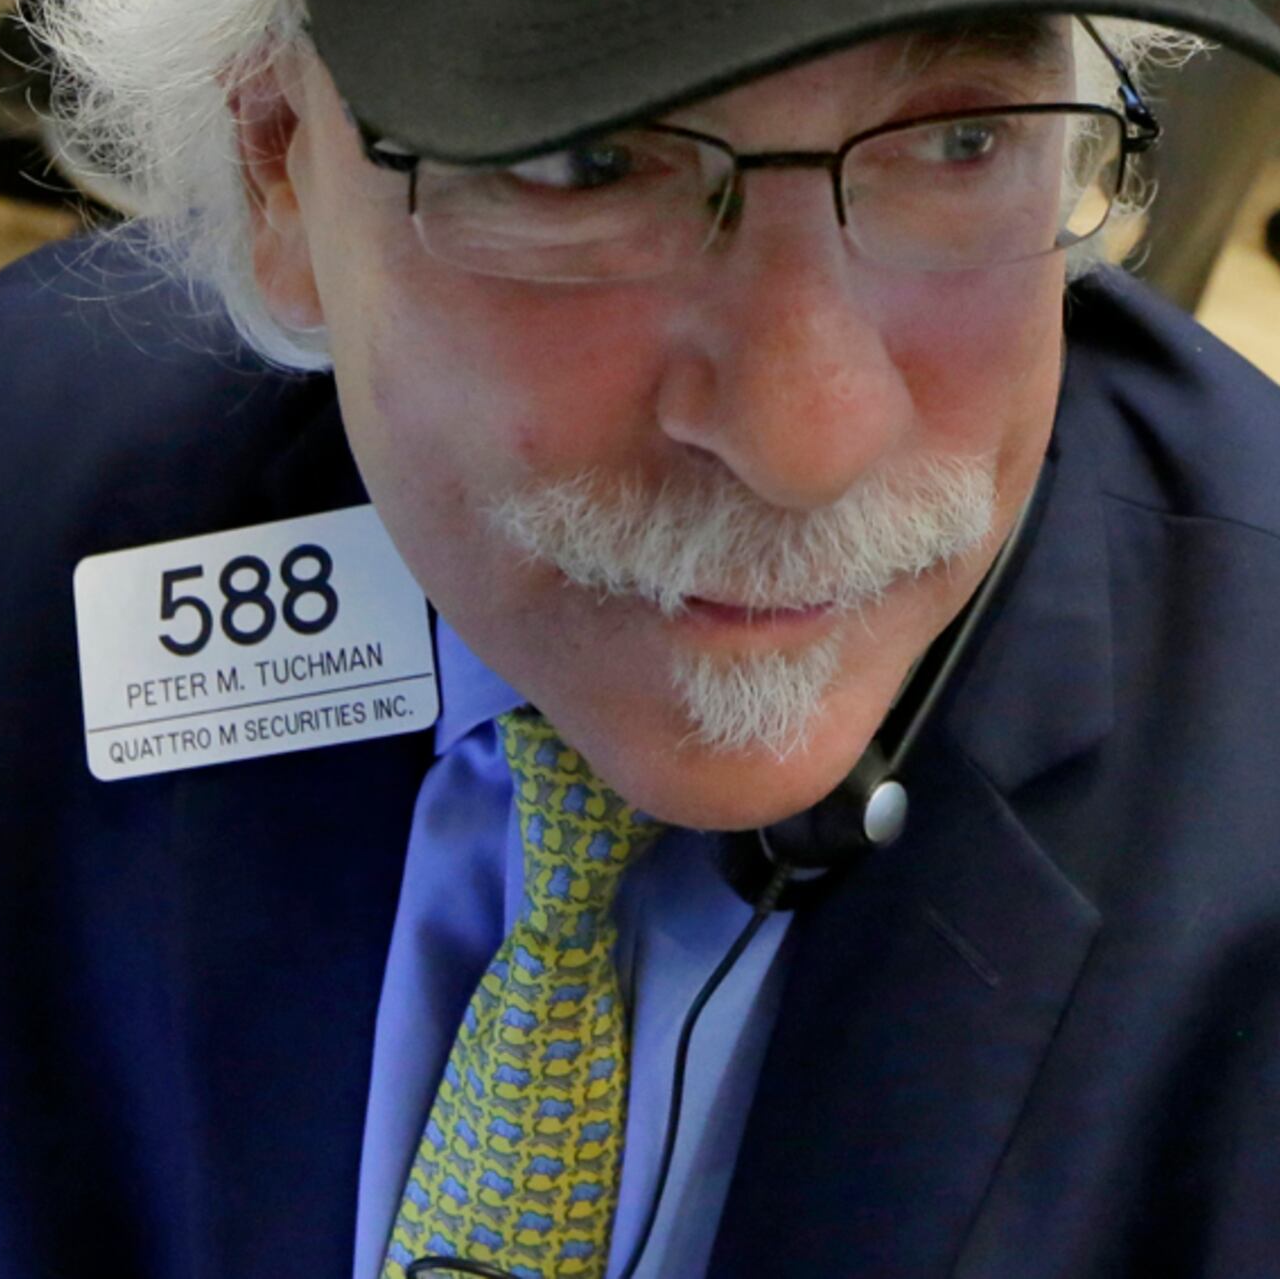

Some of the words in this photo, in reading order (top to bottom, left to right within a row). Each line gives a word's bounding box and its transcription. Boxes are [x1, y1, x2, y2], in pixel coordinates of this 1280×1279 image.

[158, 543, 340, 657] 588
[126, 672, 209, 709] PETER
[216, 666, 246, 693] M.
[255, 642, 384, 688] TUCHMAN
[108, 727, 213, 764] QUATTRO
[218, 723, 238, 746] M
[245, 702, 367, 742] SECURITIES
[372, 695, 415, 721] INC.
